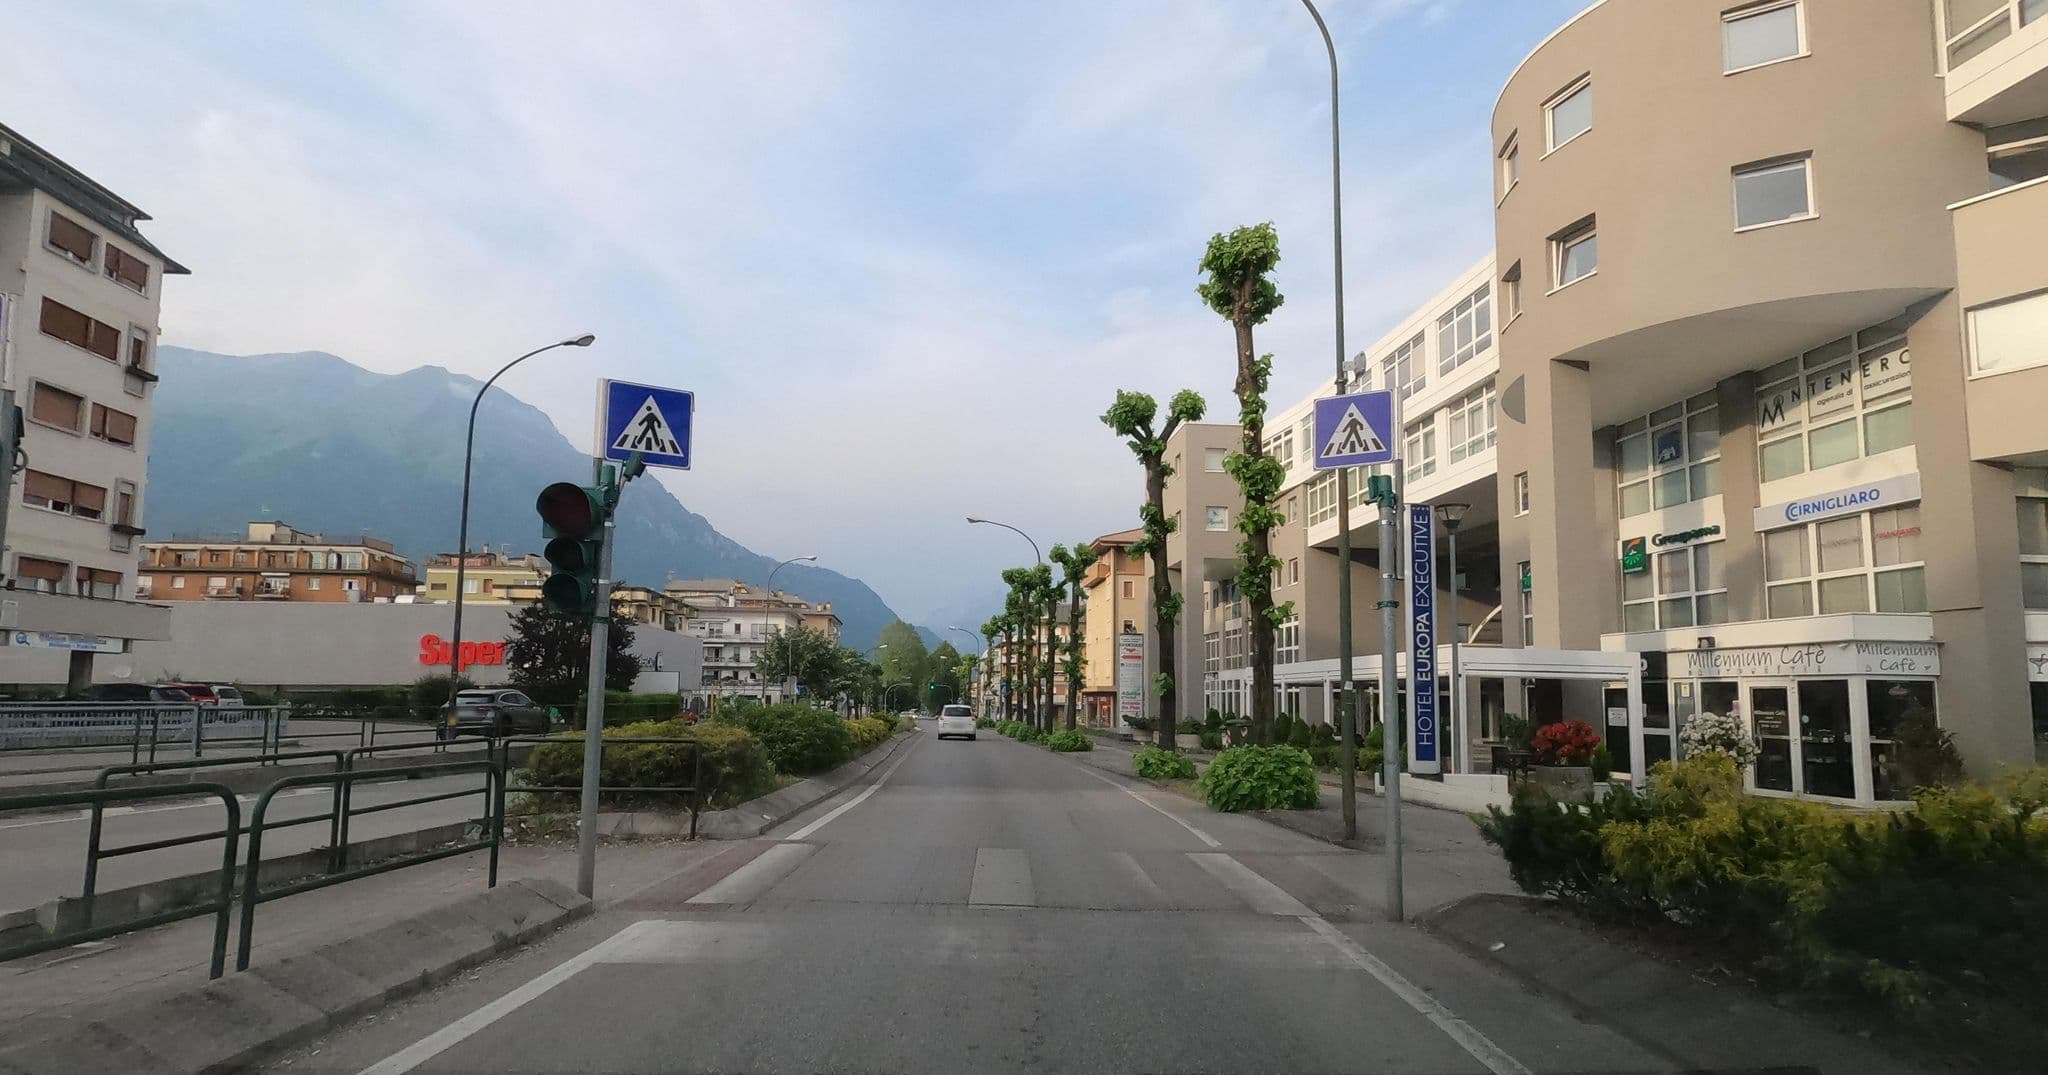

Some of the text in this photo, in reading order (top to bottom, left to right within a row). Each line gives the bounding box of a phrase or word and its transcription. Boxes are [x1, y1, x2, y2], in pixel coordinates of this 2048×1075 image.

[1785, 488, 1880, 521] CIRNIGLIARO
[1414, 514, 1433, 745] HOTEL EUROPA EXECUTIVE
[419, 633, 506, 673] Super
[1687, 649, 1773, 669] Millennium
[1856, 641, 1937, 656] Millennium
